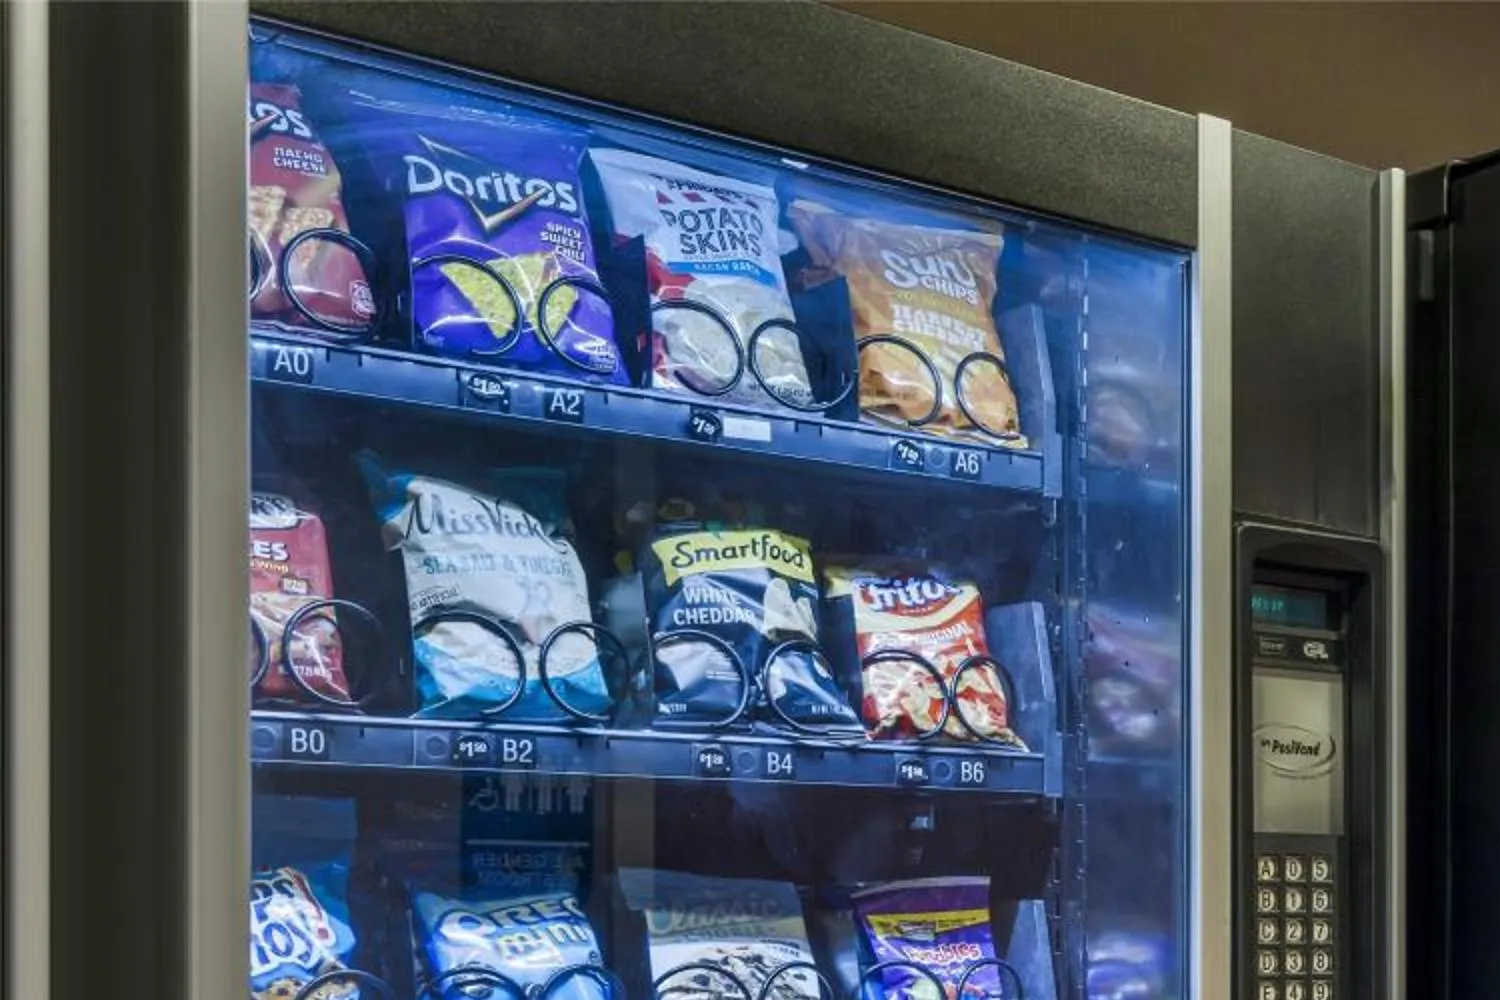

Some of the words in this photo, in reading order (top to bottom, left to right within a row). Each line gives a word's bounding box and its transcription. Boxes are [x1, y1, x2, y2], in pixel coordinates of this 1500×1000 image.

[272, 157, 326, 174] CHEESE
[273, 146, 323, 162] NACHO
[403, 154, 579, 211] Doritos
[546, 220, 582, 239] SPICY
[659, 207, 763, 236] POTATO
[539, 230, 584, 251] SWEET
[679, 230, 762, 257] SKINS
[919, 275, 978, 305] CHIPS
[274, 347, 310, 375] A0
[549, 388, 581, 416] A2
[954, 454, 980, 476] A6
[671, 533, 805, 569] Smartfood
[682, 584, 741, 605] WHITE
[673, 607, 756, 626] CHEDDAR
[290, 729, 326, 754] B0
[502, 738, 533, 763] B2
[766, 751, 793, 775] B4
[960, 760, 985, 784] B6
